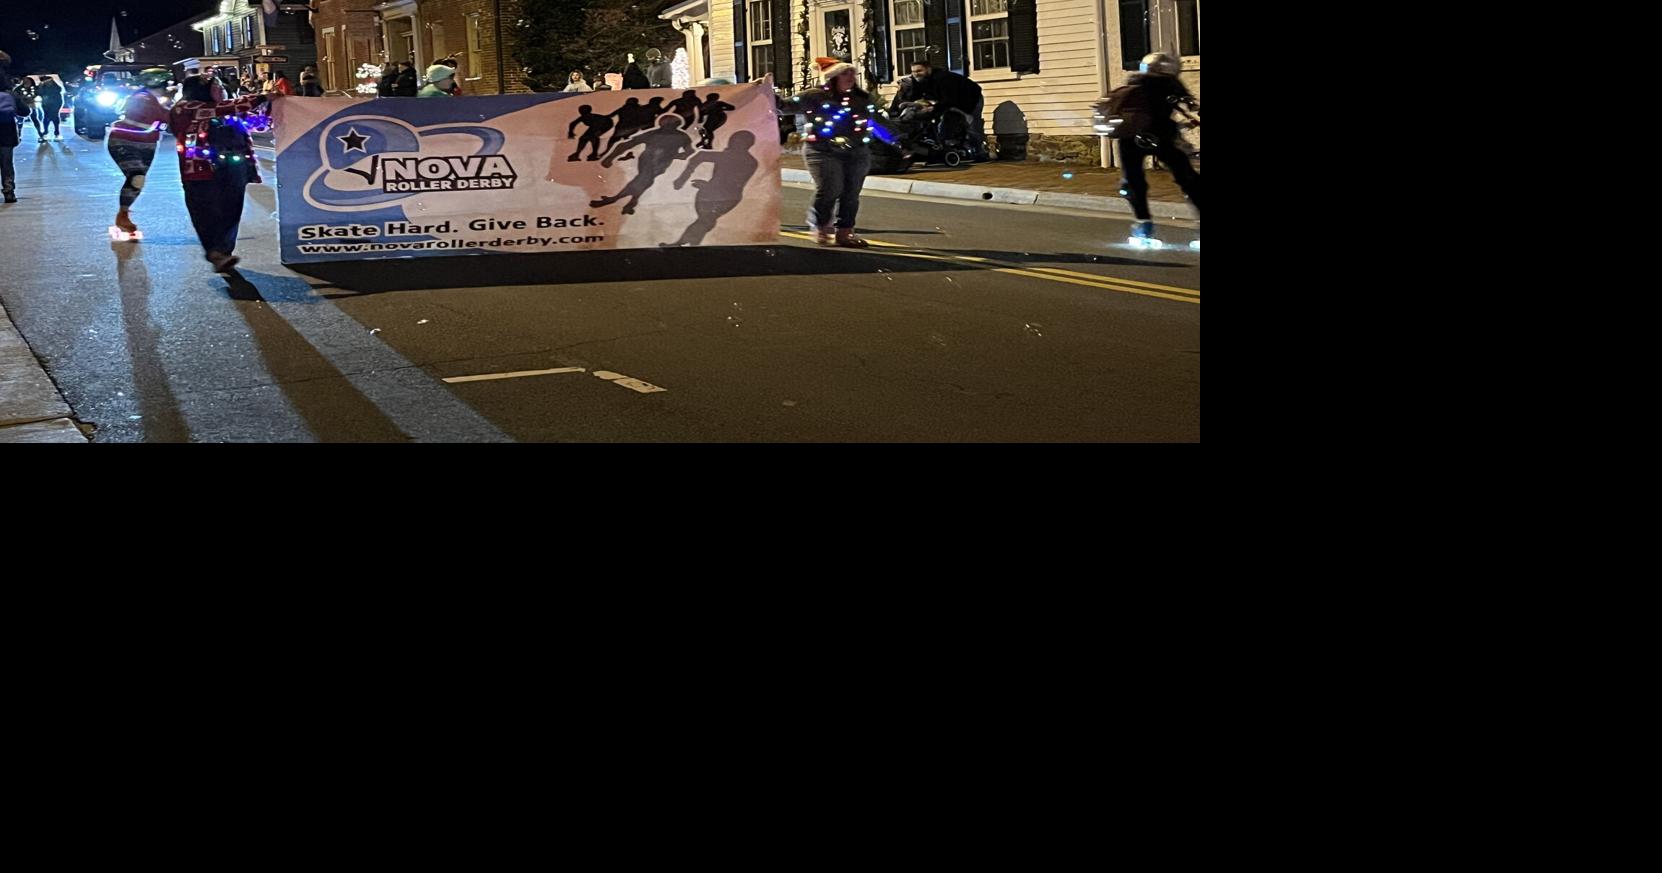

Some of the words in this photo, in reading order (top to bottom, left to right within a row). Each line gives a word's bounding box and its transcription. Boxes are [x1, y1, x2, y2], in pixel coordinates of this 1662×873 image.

[384, 156, 514, 180] NOVA
[386, 180, 452, 192] ROLLER
[457, 178, 513, 190] DERBY
[301, 225, 378, 239] Skate
[388, 220, 459, 235] Hard.
[468, 218, 527, 231] Give
[536, 214, 605, 229] Back.
[301, 235, 604, 253] www.novarollerderby.com
